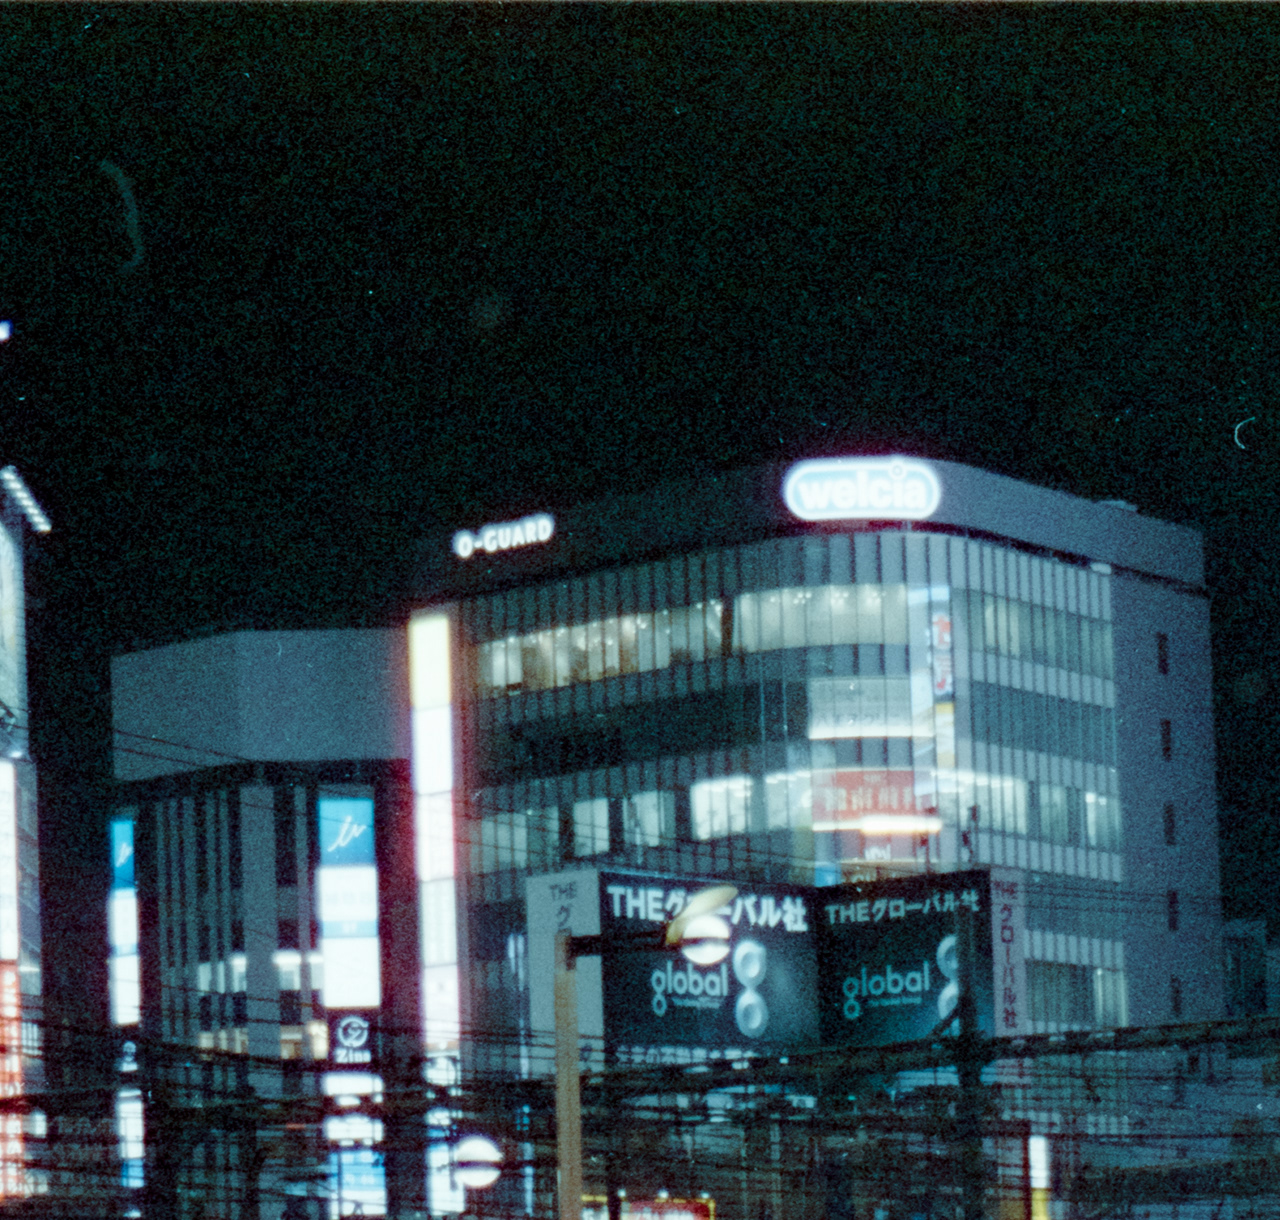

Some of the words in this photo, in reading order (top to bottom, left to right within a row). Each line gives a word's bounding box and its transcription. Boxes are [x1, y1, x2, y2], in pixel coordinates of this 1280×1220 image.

[796, 468, 923, 511] welcia
[454, 513, 554, 559] O-GUARD
[607, 884, 809, 933] THEグーバル社
[651, 962, 729, 1018] global
[842, 960, 931, 1021] global
